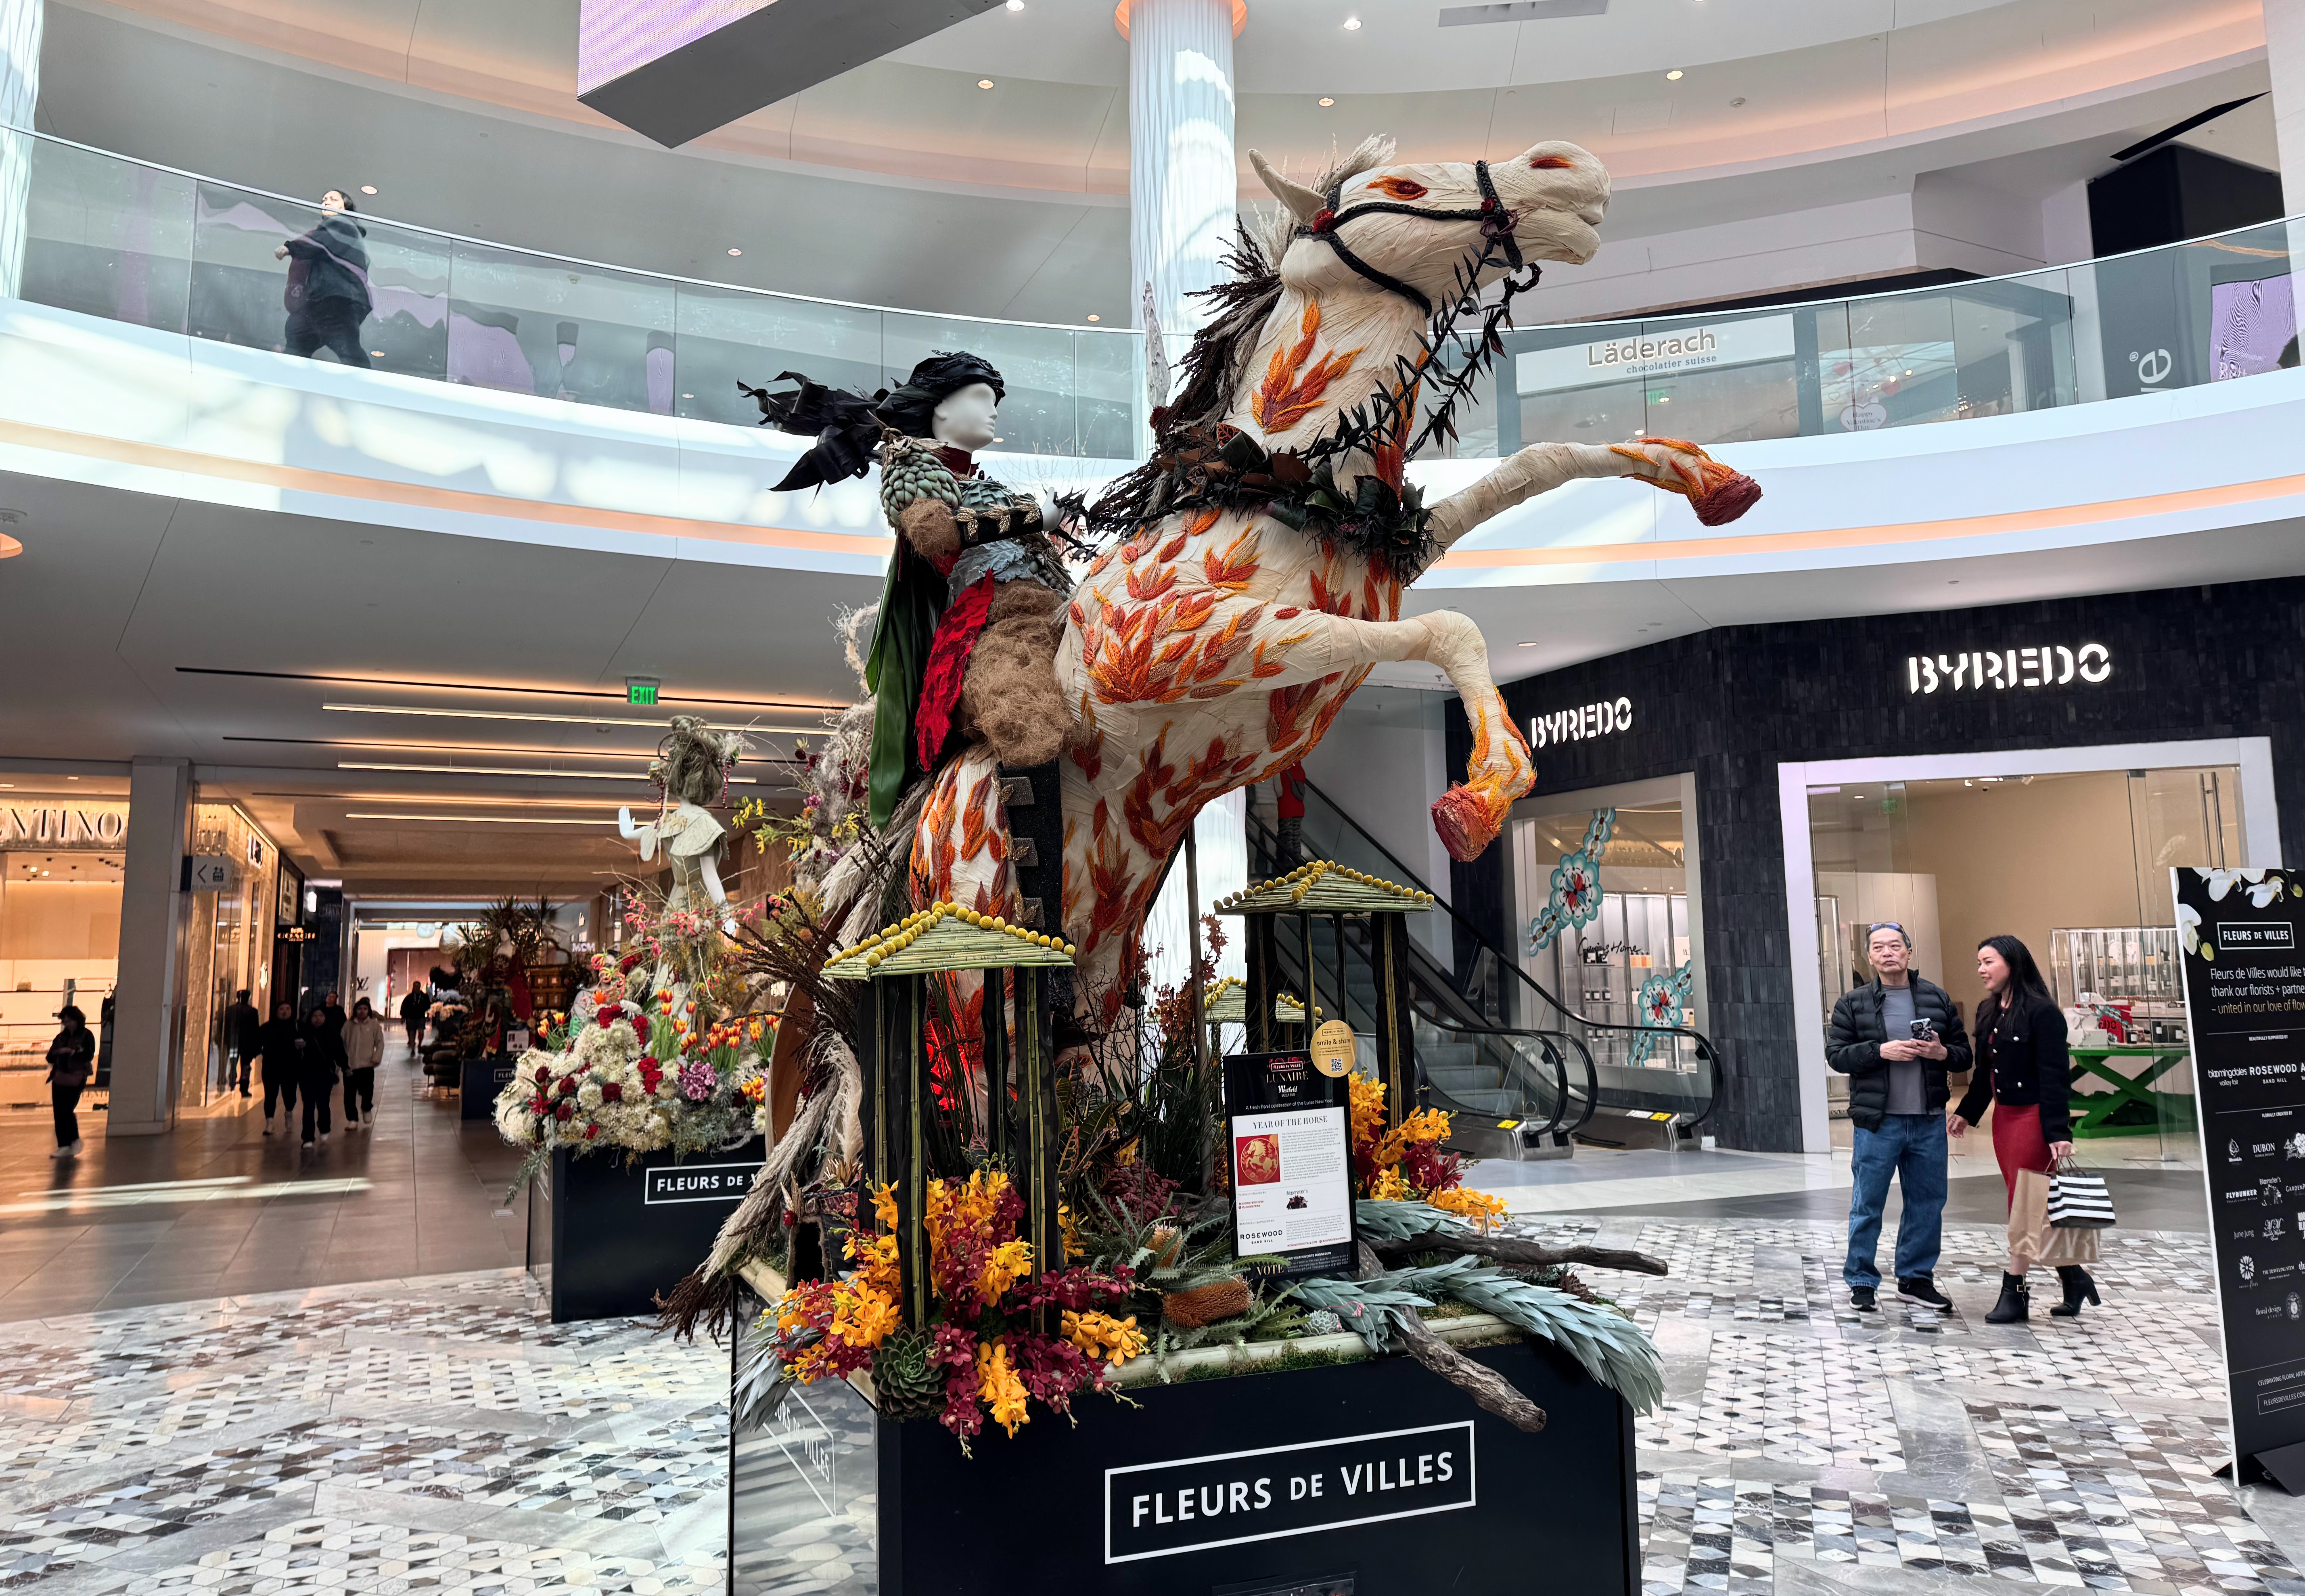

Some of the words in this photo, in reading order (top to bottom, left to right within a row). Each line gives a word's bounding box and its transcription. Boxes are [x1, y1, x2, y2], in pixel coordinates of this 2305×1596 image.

[1588, 328, 1717, 368] Läderach
[1626, 359, 1682, 374] chocolatier
[1685, 355, 1717, 366] suisse
[1908, 643, 2110, 694] BYREDO
[631, 686, 656, 705] EXIT
[1531, 697, 1632, 749] BYREDO
[0, 808, 122, 840] NTINO
[2223, 931, 2252, 941] FLEURS
[2264, 931, 2289, 940] VILLES
[572, 942, 595, 952] MCM
[1611, 941, 1642, 954] Home
[2211, 968, 2234, 980] Fleurs
[2236, 967, 2246, 979] de
[2246, 967, 2266, 979] Villes
[2267, 966, 2288, 978] would
[2290, 966, 2302, 977] like
[2211, 985, 2234, 997] thank
[2235, 987, 2248, 996] our
[2249, 984, 2275, 996] florists
[2218, 1002, 2242, 1014] united
[2244, 1002, 2252, 1013] in
[2253, 1003, 2266, 1012] our
[2267, 1000, 2282, 1012] love
[2284, 999, 2291, 1011] of
[2249, 1064, 2297, 1075] ROSEWOOD
[1266, 1071, 1309, 1083] LUNAIRE
[1278, 1085, 1298, 1093] Westfield
[1253, 1121, 1273, 1129] YEAR
[1274, 1119, 1284, 1127] OF
[1286, 1118, 1302, 1126] THE
[1304, 1115, 1328, 1124] HORSE
[2253, 1142, 2276, 1153] DUBON
[657, 1175, 720, 1192] FLEURS
[727, 1175, 743, 1186] DE
[2226, 1189, 2257, 1199] FLYBUNKER
[1240, 1230, 1283, 1240] ROSEWOOD
[1257, 1264, 1284, 1276] VOTE
[2256, 1307, 2267, 1316] floral
[2268, 1305, 2282, 1313] design
[2258, 1376, 2282, 1386] CELEBRATING
[775, 1400, 791, 1433] URS
[803, 1425, 830, 1483] VILLES
[1133, 1477, 1271, 1527] FLEURS
[1291, 1473, 1323, 1501] DE
[1341, 1451, 1453, 1496] VILLES
